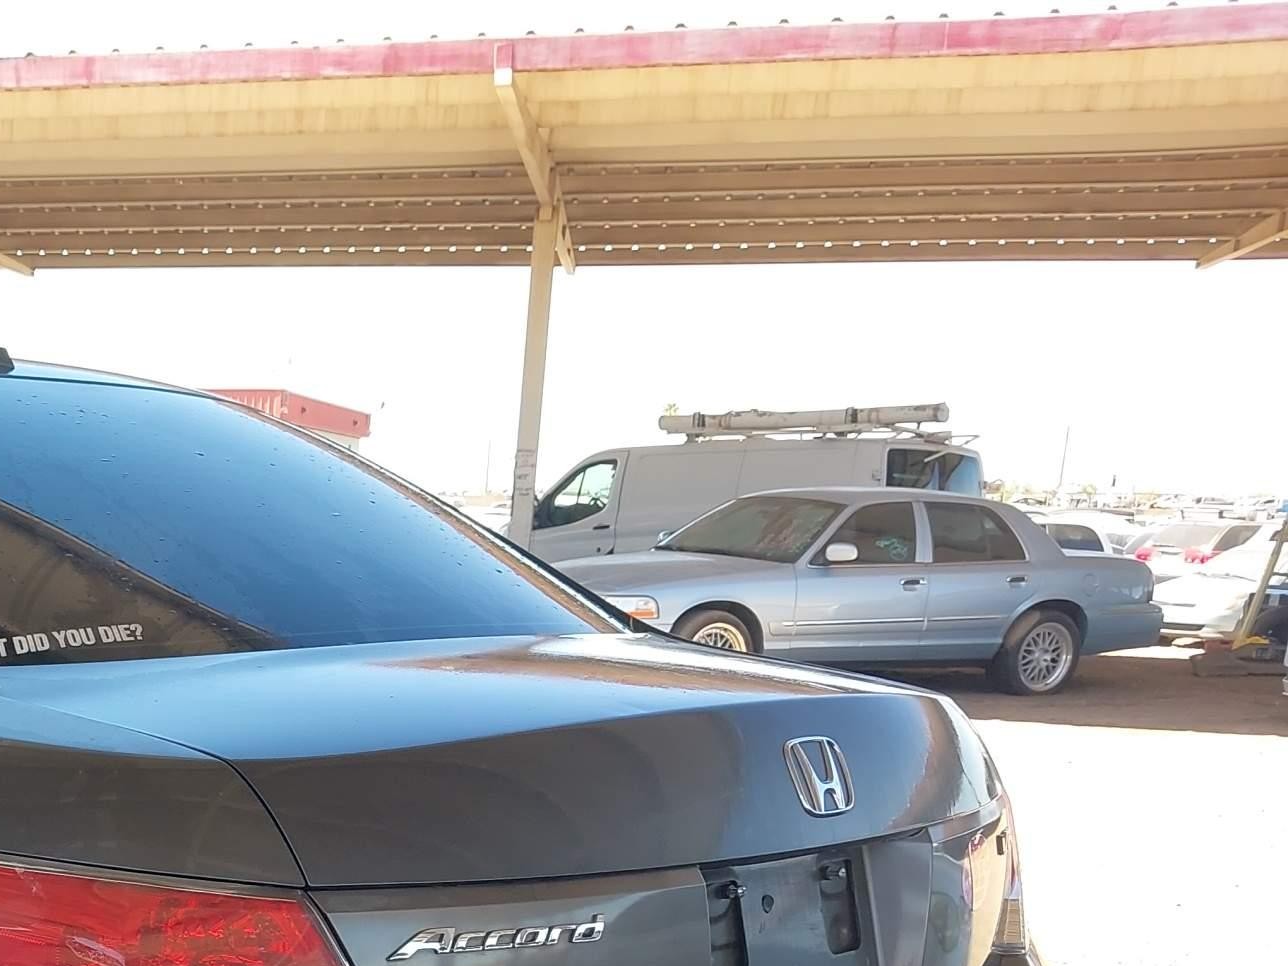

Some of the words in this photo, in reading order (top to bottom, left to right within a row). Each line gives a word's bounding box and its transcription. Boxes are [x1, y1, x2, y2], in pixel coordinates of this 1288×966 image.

[11, 632, 50, 655] DID
[51, 627, 97, 649] YOU
[98, 623, 144, 643] DIE?
[385, 913, 606, 962] Accord
